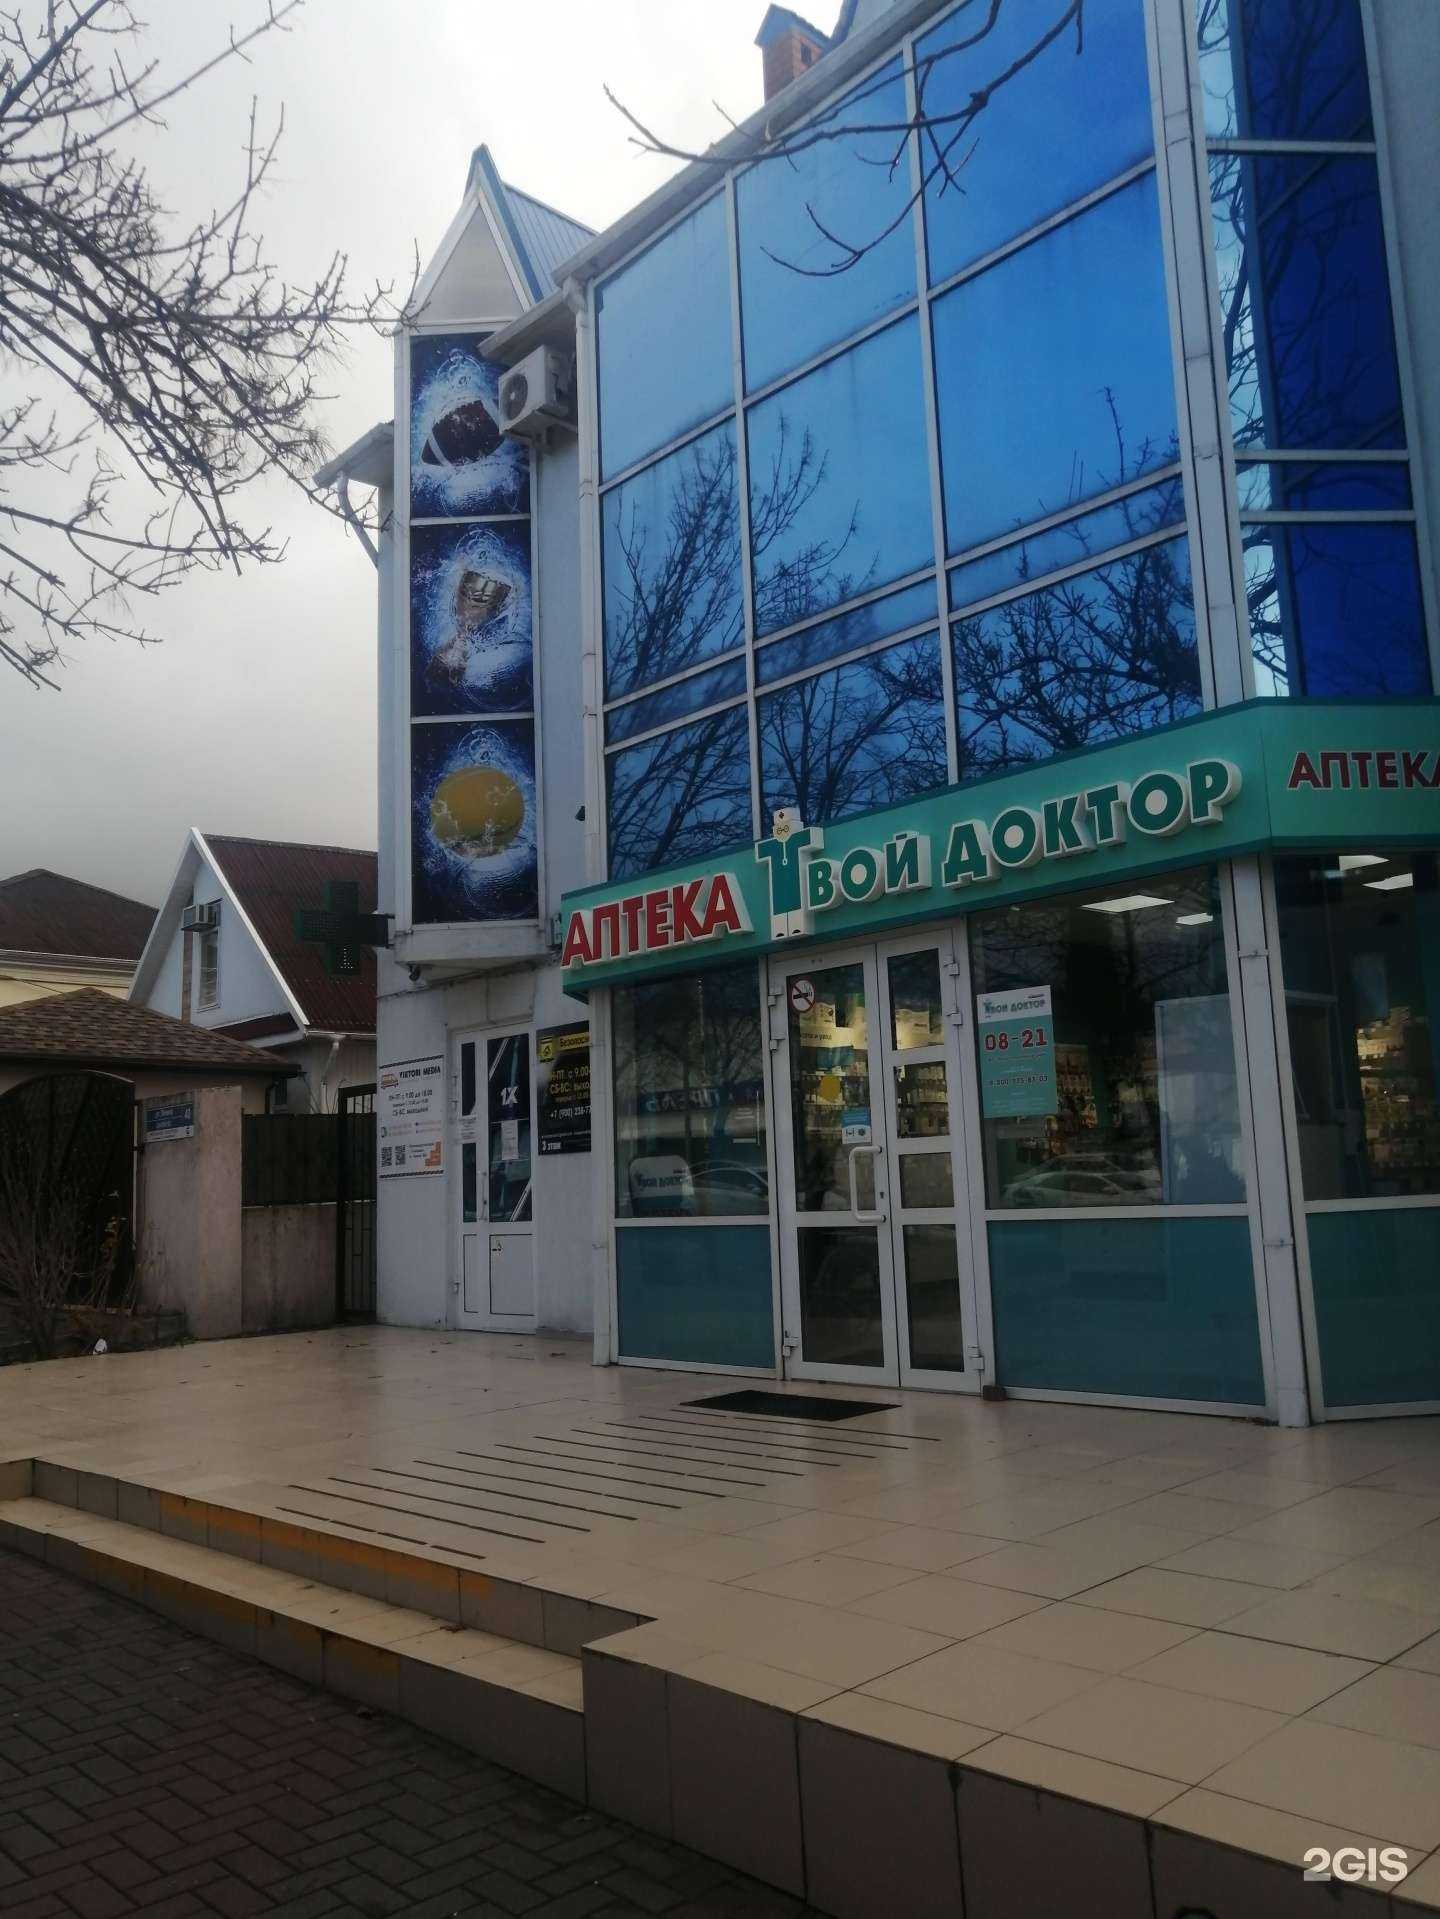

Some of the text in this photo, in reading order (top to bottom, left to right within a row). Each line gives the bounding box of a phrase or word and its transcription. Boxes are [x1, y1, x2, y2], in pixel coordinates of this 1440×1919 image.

[1287, 751, 1440, 791] АПТЕК
[562, 872, 752, 970] АПТЕКА
[942, 758, 1242, 887] ДОКТОР
